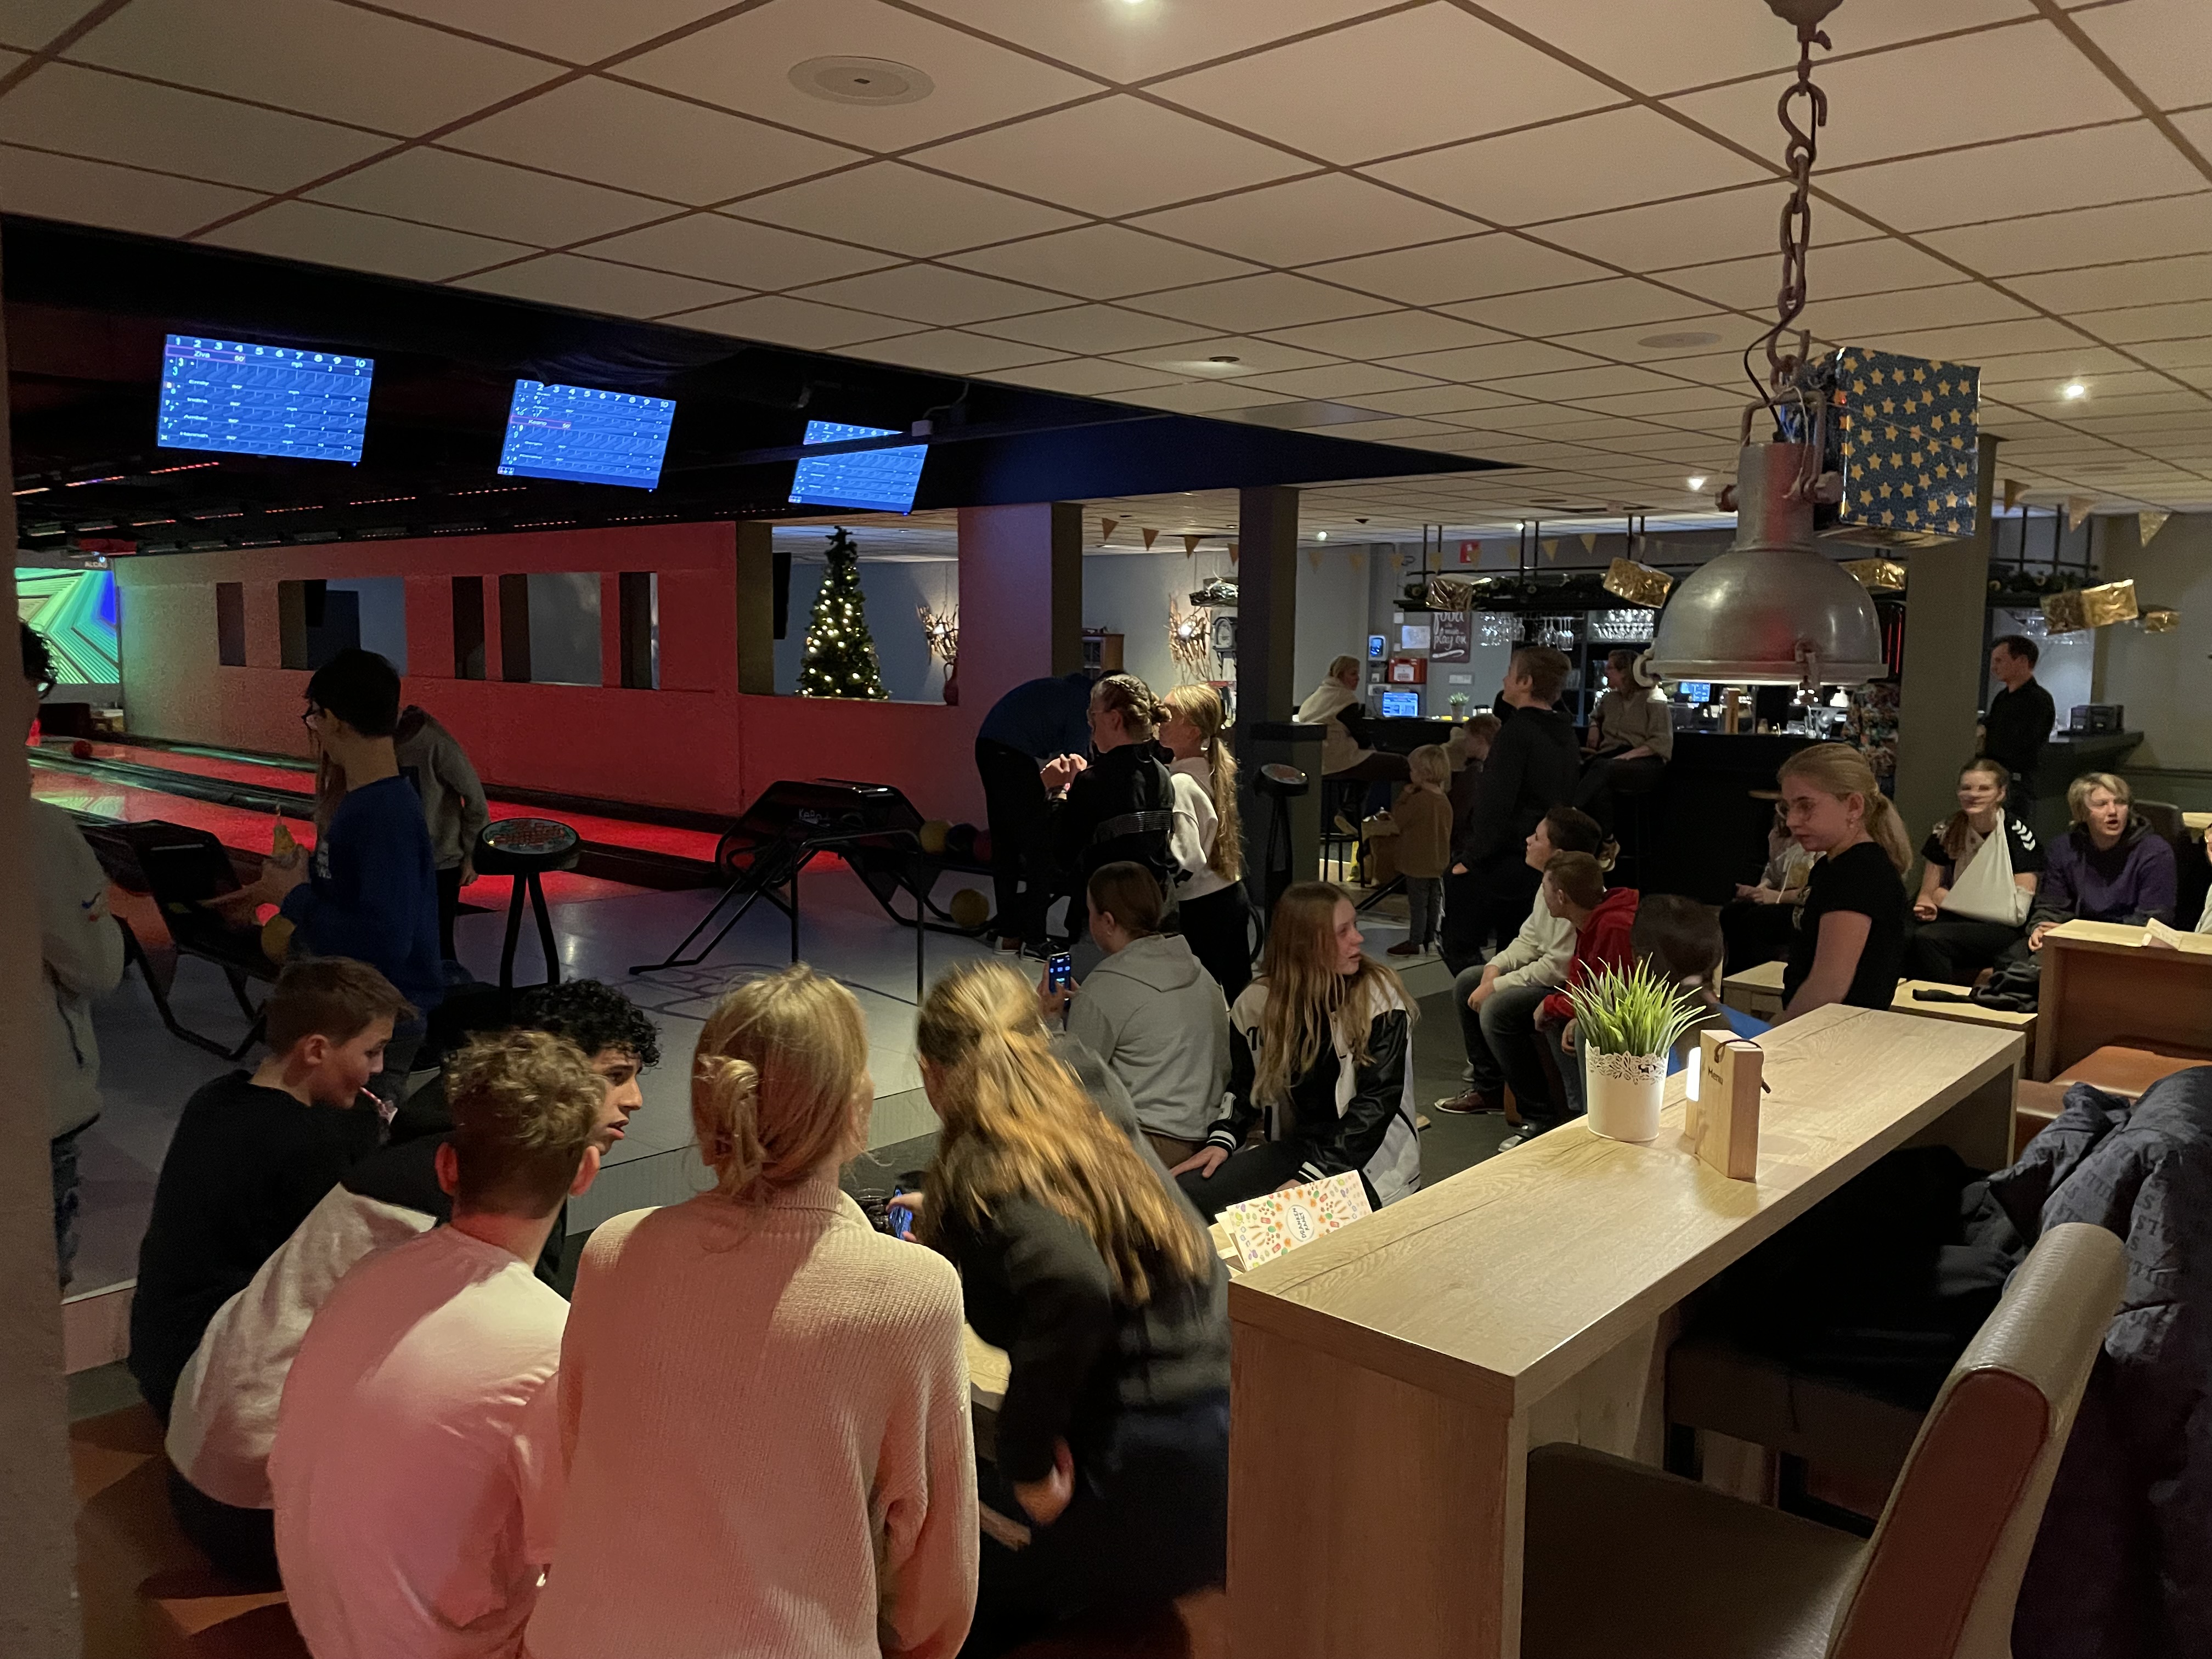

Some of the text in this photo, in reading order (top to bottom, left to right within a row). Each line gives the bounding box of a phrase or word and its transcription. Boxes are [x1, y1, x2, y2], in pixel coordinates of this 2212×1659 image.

[175, 336, 366, 368] 1 2 3 4 5 6 7 8 9 10
[1707, 1066, 1724, 1086] Menu
[1293, 1208, 1307, 1238] DRANKEN
